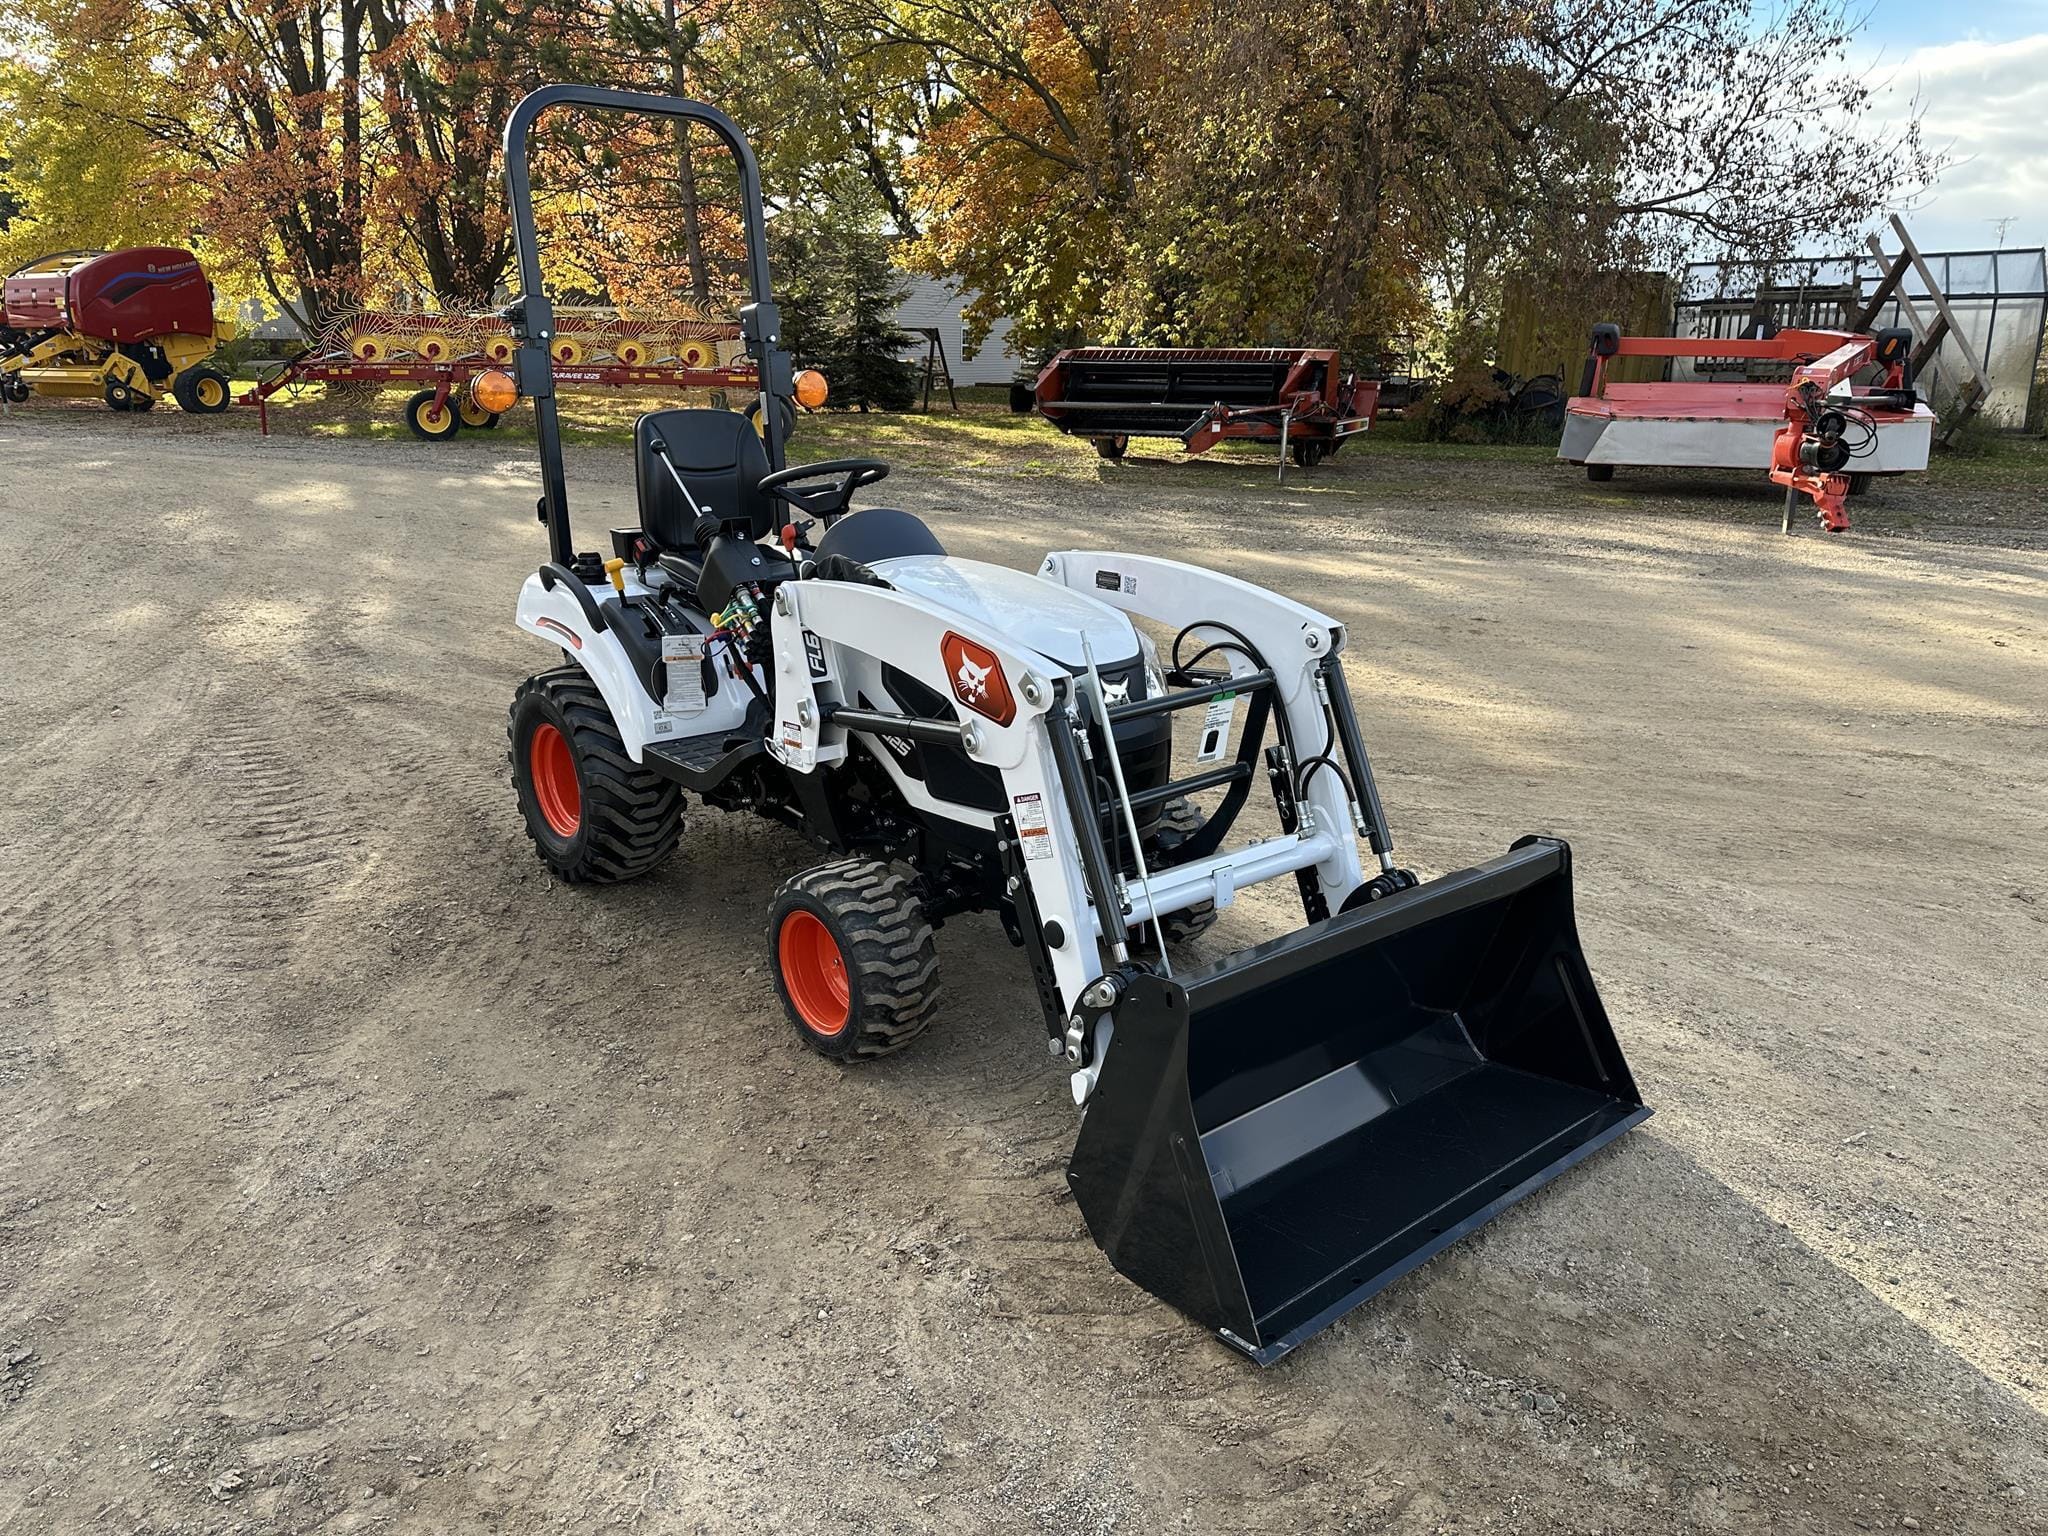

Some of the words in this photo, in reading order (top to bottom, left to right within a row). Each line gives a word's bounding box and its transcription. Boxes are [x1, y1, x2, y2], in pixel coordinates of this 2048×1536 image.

[158, 265, 171, 273] NEW
[172, 260, 197, 270] HOLLAND
[804, 632, 826, 674] FL6
[1020, 794, 1040, 802] DANGER
